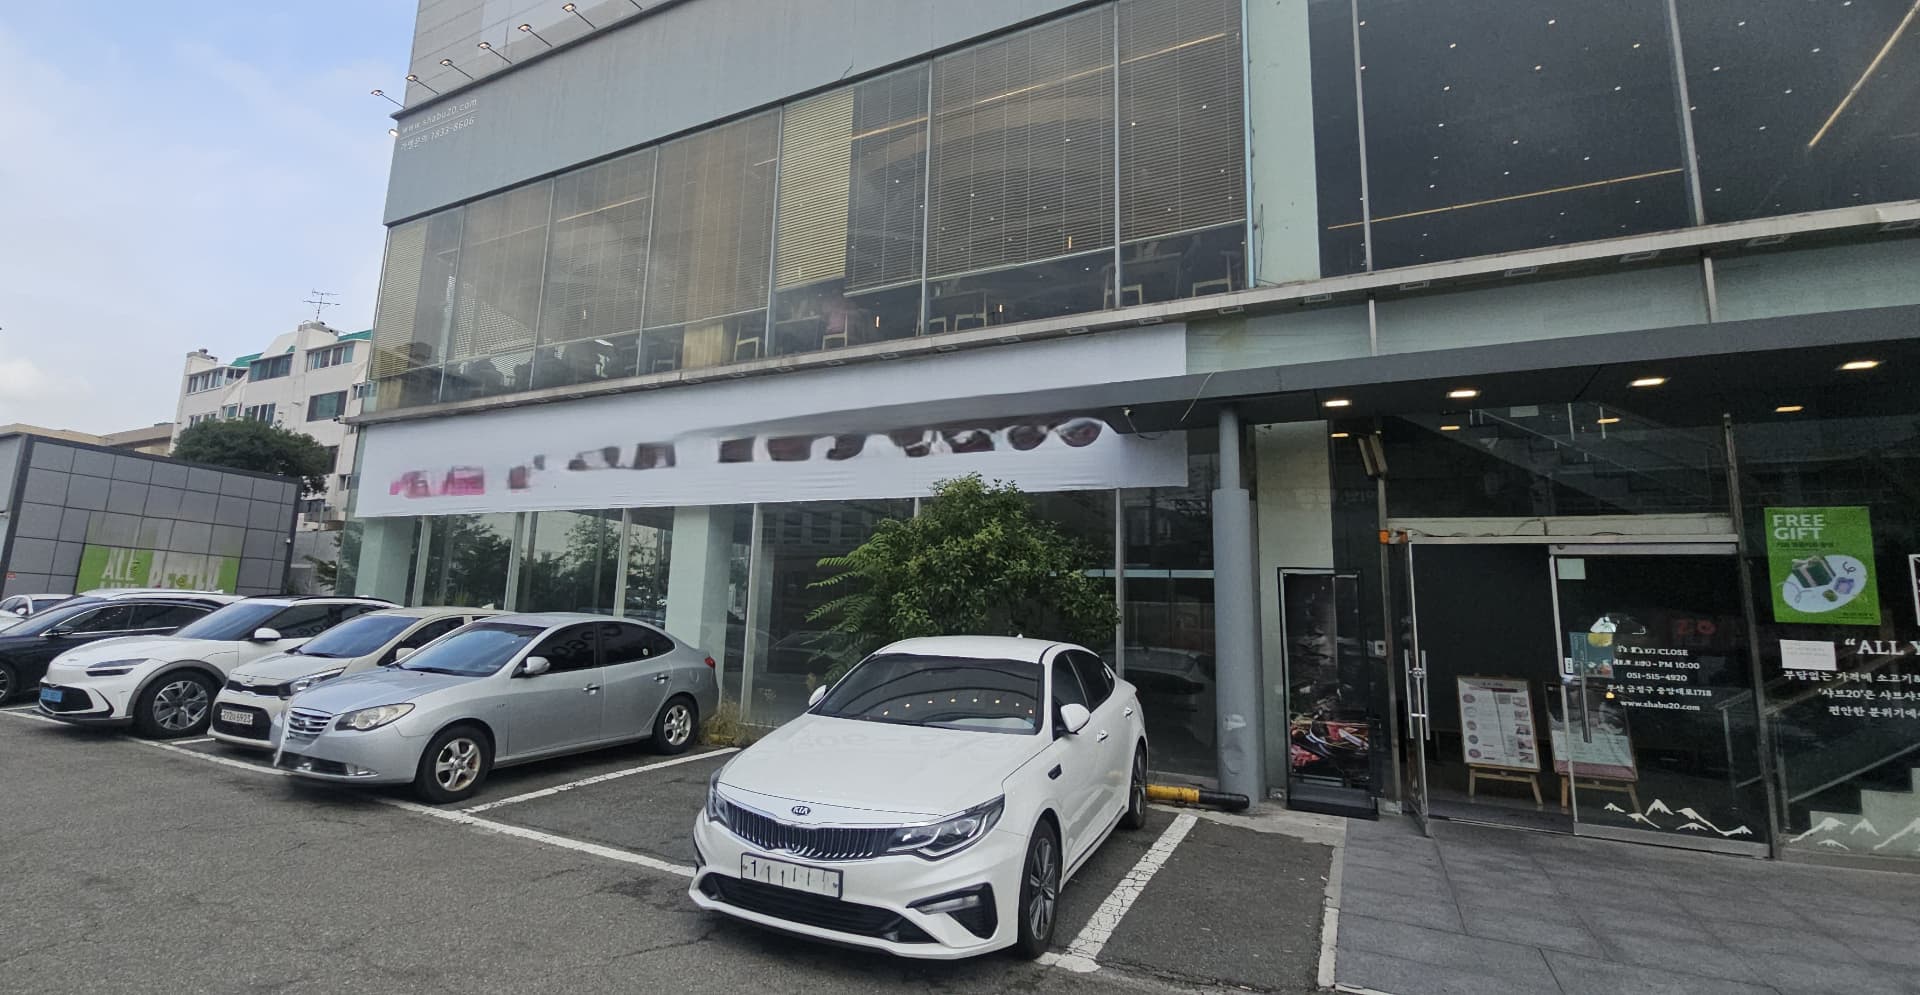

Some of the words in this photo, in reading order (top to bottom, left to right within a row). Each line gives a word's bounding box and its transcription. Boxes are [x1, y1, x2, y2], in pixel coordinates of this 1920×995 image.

[403, 99, 478, 132] www.shabu20.com
[1773, 514, 1825, 527] FREE
[1774, 527, 1824, 540] GIFT
[1675, 662, 1700, 670] 10:00
[1626, 672, 1687, 681] 051-515-4920
[1783, 670, 1833, 682] 부담없는
[1836, 671, 1873, 683] 가격에
[1620, 700, 1700, 711] www.shabu20.com
[1828, 705, 1865, 717] 편안한
[1868, 706, 1920, 719] 분위기에
